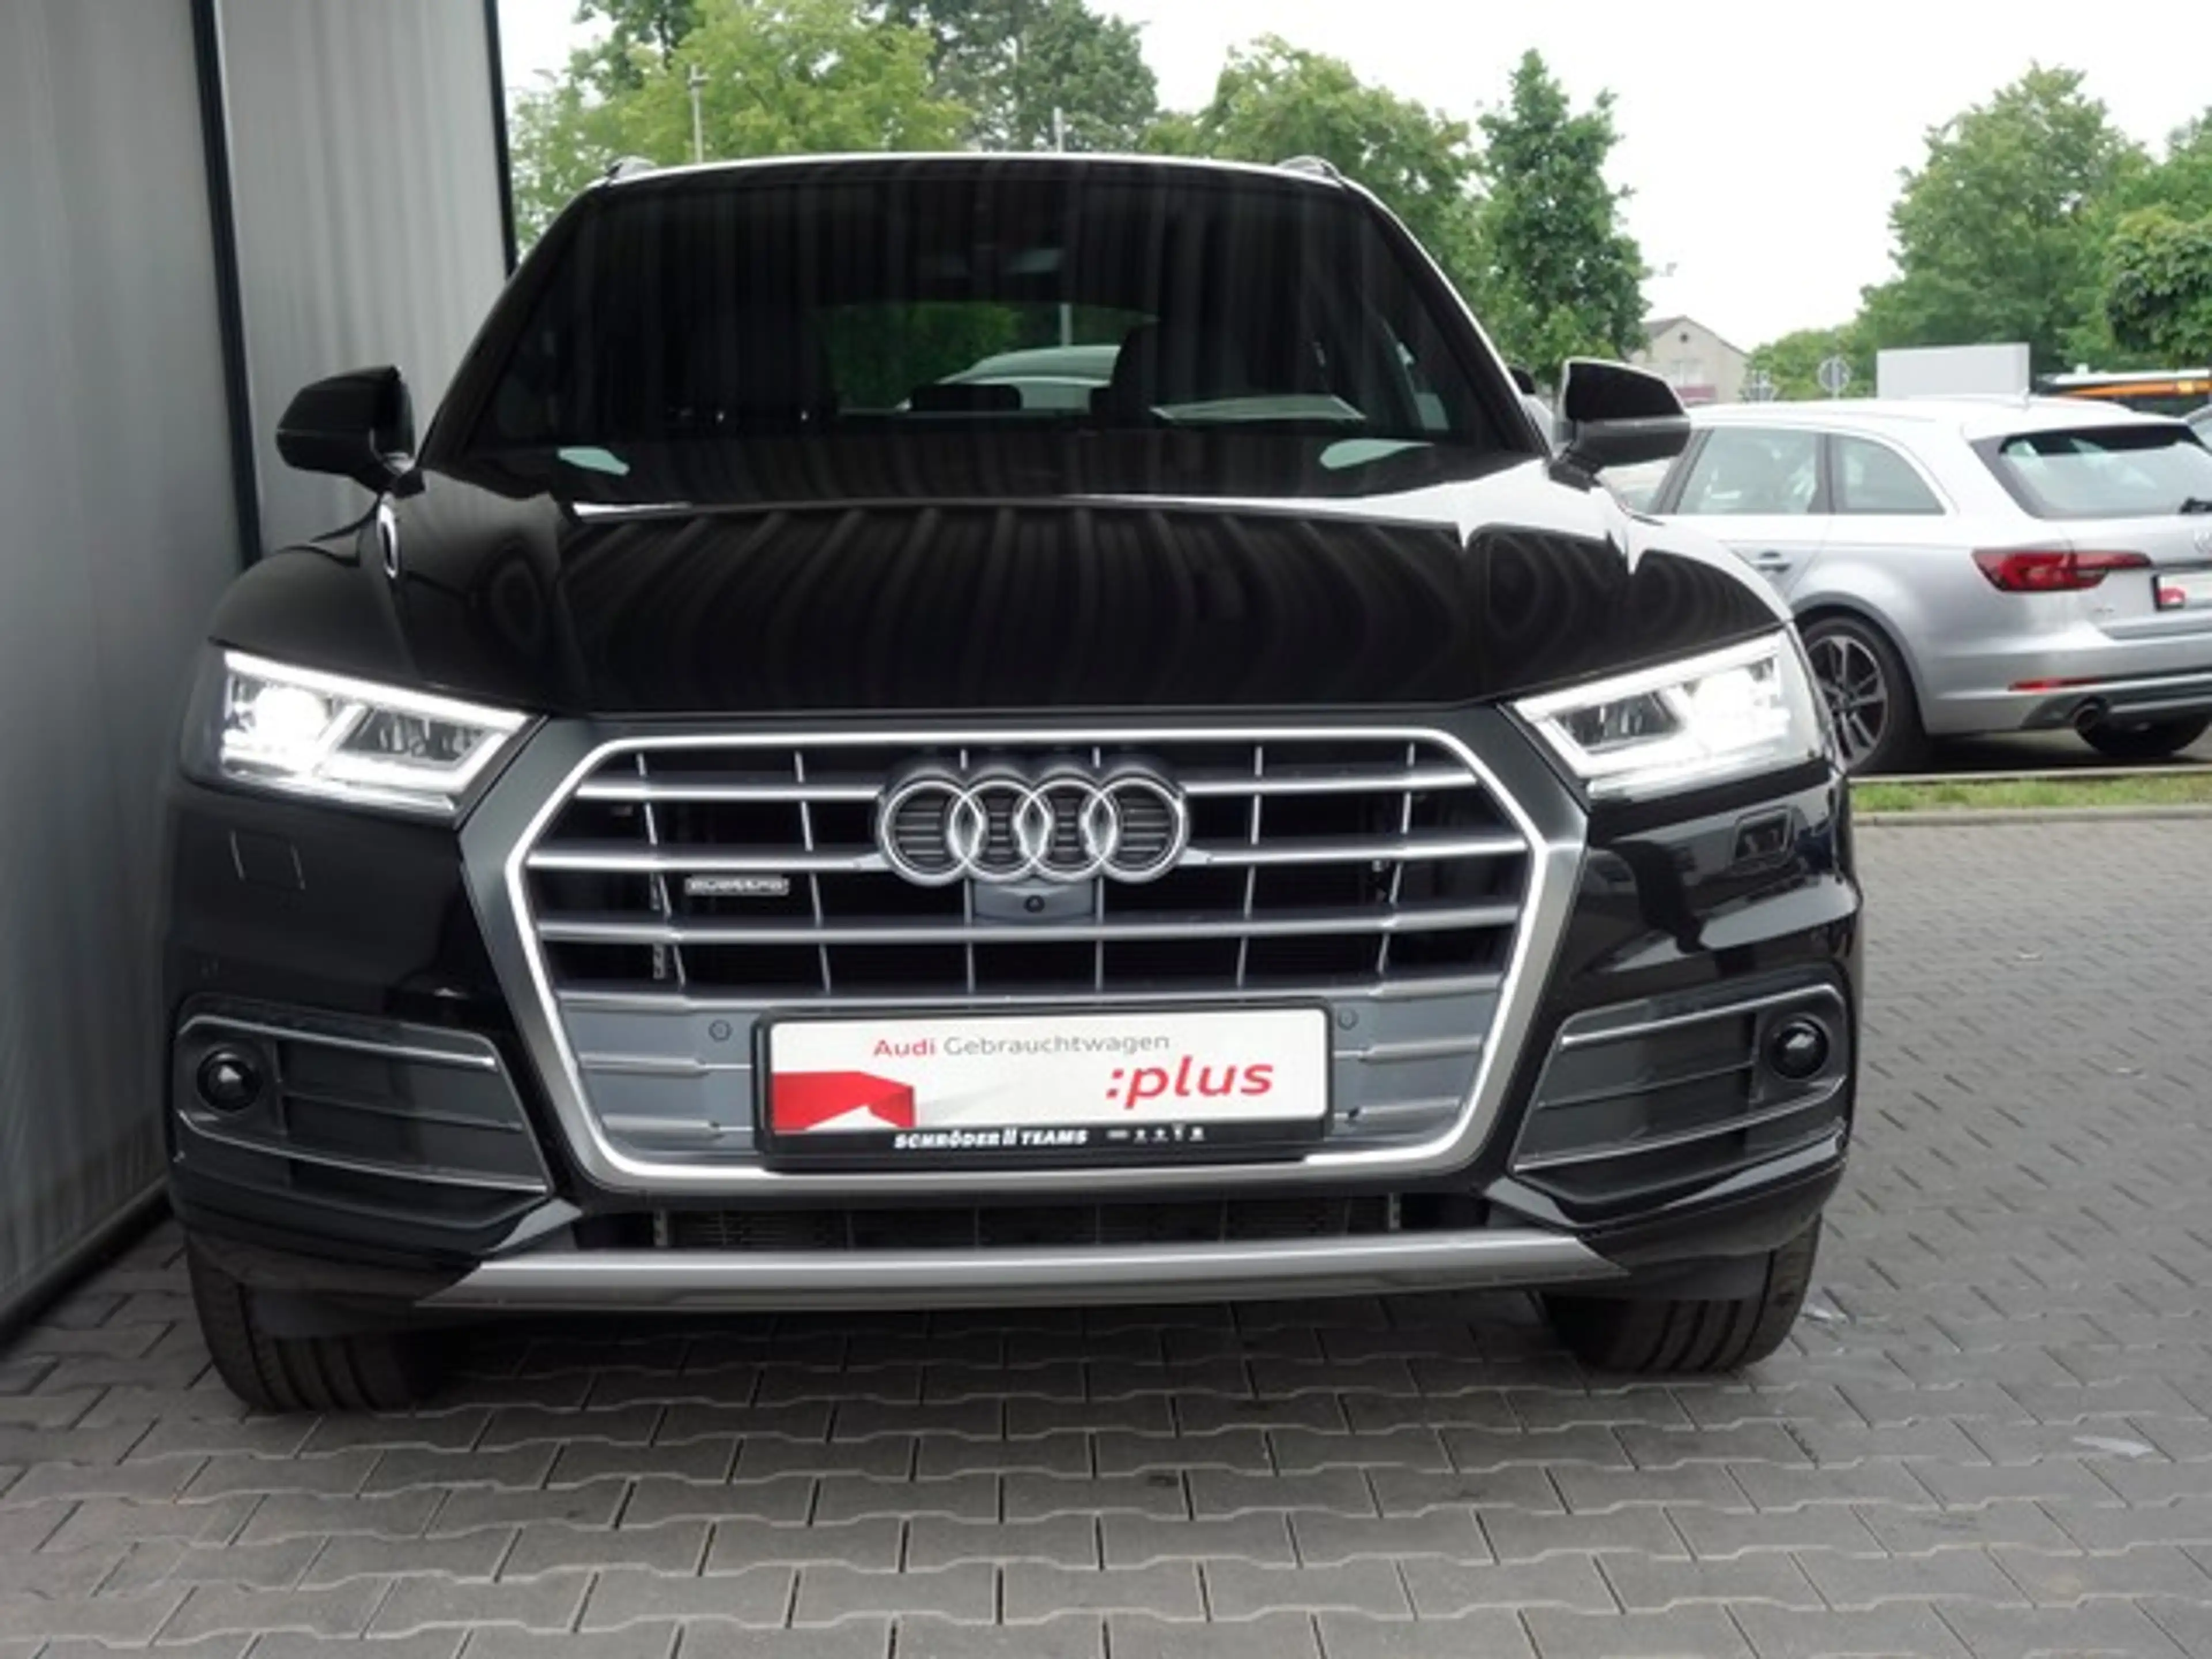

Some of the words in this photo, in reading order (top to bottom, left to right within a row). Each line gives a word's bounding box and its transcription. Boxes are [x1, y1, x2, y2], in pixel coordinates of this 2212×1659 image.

[873, 1039, 935, 1057] Audi
[944, 1034, 1171, 1057] Gebrauchtwagen
[1106, 1056, 1274, 1109] :plus
